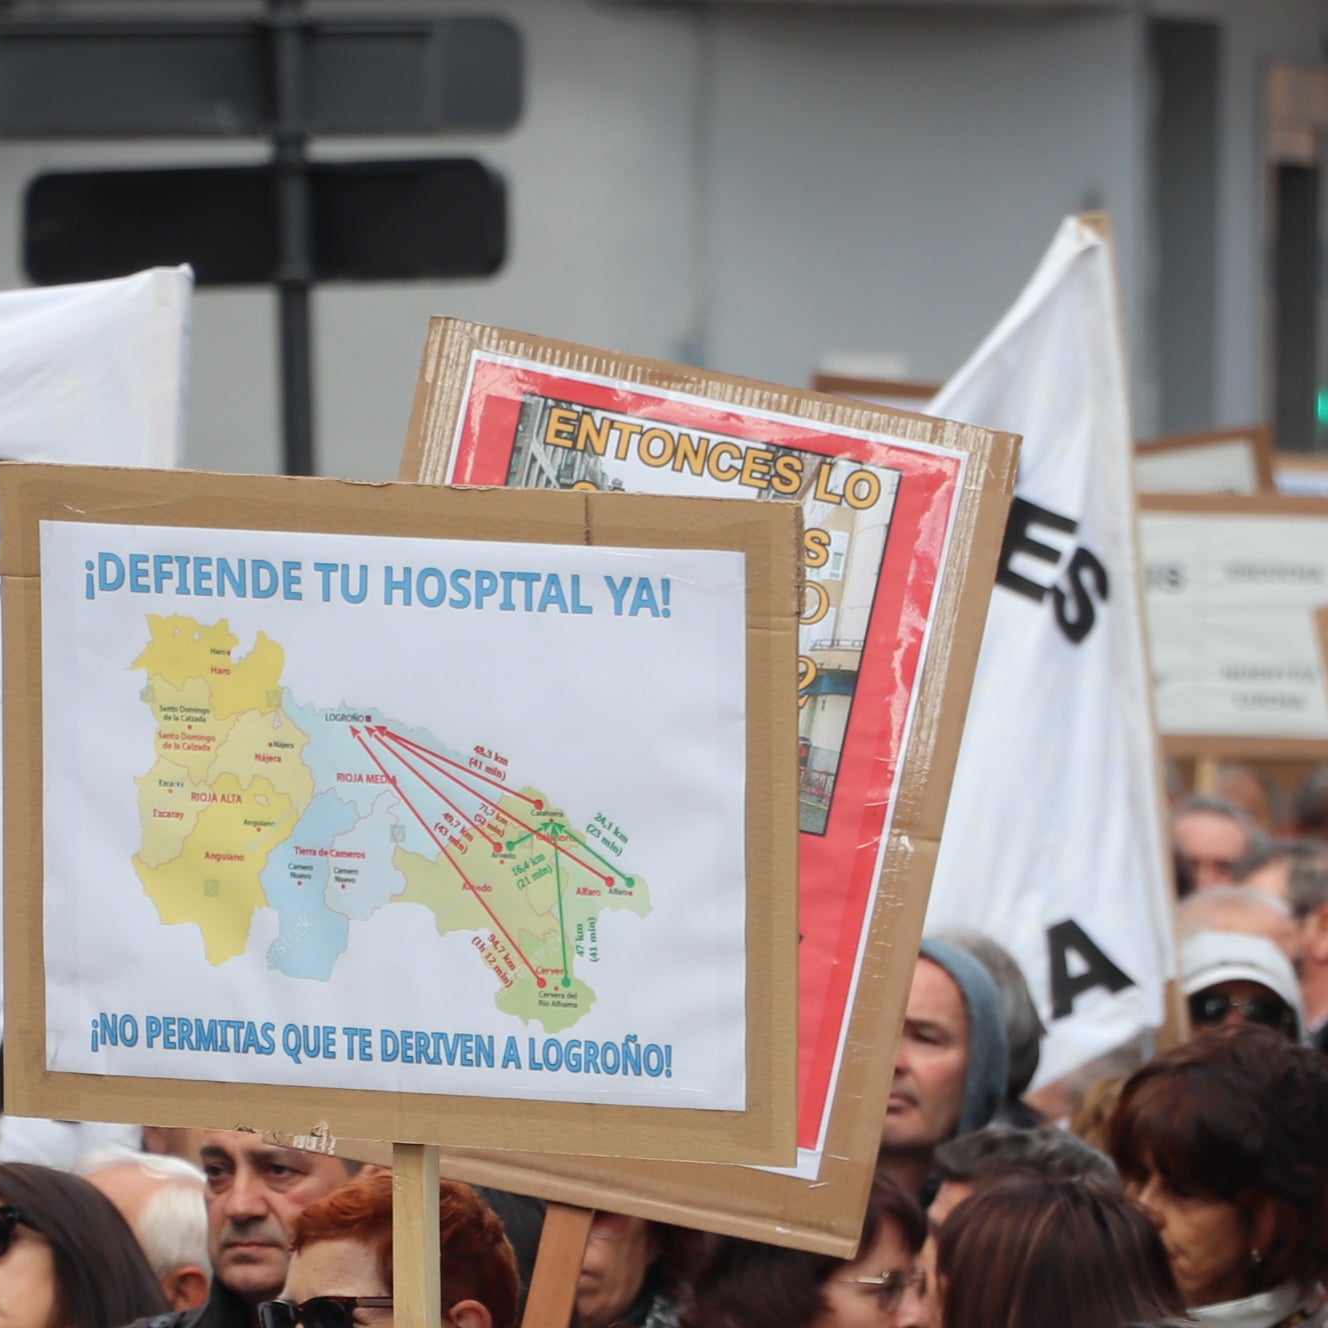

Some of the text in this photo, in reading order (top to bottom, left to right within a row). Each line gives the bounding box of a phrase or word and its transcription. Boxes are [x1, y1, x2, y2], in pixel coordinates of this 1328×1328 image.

[544, 407, 881, 511] ENTONCES LO
[85, 551, 671, 619] ¡DEFIENDE TU HOSPITAL YA!
[211, 666, 232, 676] Haro
[159, 705, 211, 715] Santo Domingo
[173, 714, 180, 722] la
[180, 715, 207, 723] Calzada
[325, 713, 365, 723] LOGROÑO
[158, 731, 216, 743] Santo Domingo
[162, 742, 211, 752] de la Calzada
[255, 753, 282, 763] Nájera
[469, 757, 483, 771] (41
[494, 752, 508, 767] km
[336, 773, 365, 784] RIOJA
[191, 791, 244, 804] RIOJA ALTA
[152, 809, 185, 820] Ezcaray
[495, 813, 508, 827] km
[459, 826, 474, 843] km
[586, 823, 600, 838] (23
[594, 812, 630, 844] 24,1 km
[204, 852, 245, 863] Anguiano
[294, 846, 366, 860] Tierra de Cameros
[528, 853, 546, 868] km
[288, 863, 315, 872] Camero
[333, 866, 359, 876] Camero
[290, 871, 313, 881] Nuevo
[334, 874, 356, 884] Nuevo
[516, 875, 532, 890] (21
[576, 887, 602, 897] Alfaro
[575, 923, 585, 957] 47 km
[587, 916, 600, 963] (41 min)
[484, 952, 495, 966] 12
[504, 952, 518, 971] km
[538, 990, 578, 1000] Cervera del
[90, 1012, 673, 1078] ¡NO PERMITAS QUE TE DERIVEN A LOGROÑO!
